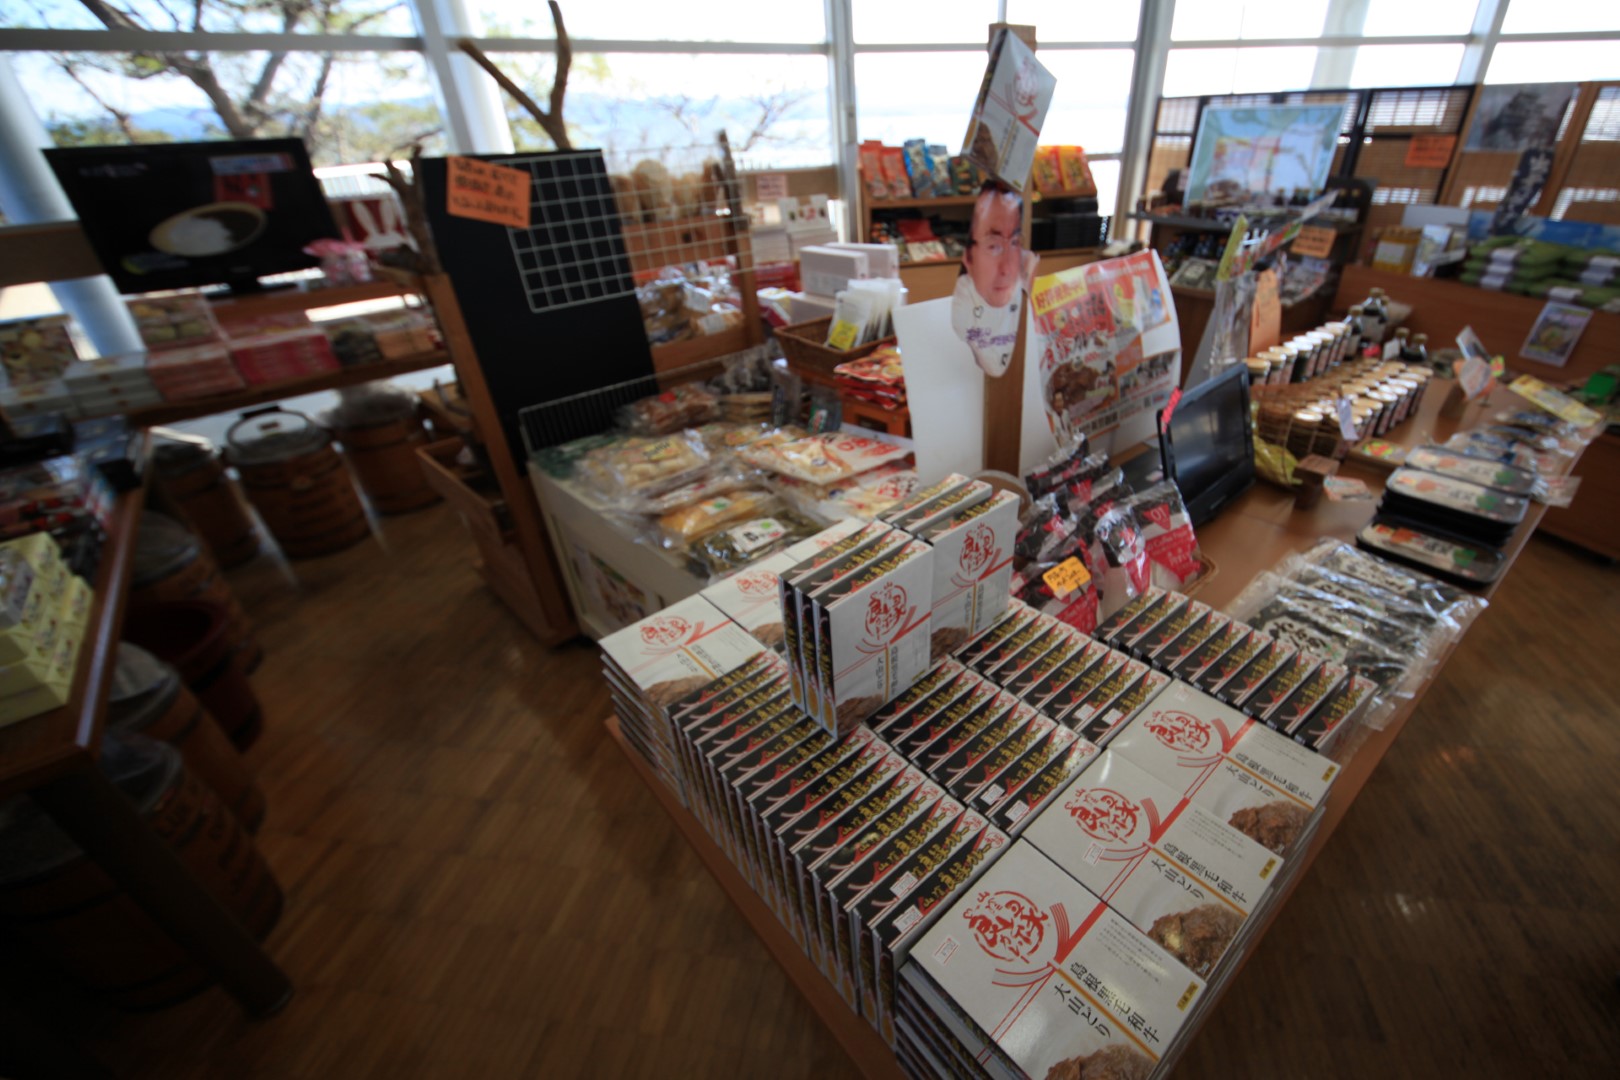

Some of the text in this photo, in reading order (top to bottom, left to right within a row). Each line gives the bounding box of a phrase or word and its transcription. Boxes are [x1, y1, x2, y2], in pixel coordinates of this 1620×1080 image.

[912, 826, 970, 877] 陰良縁カレー
[1162, 843, 1248, 904] 島根黒毛和牛
[1150, 858, 1206, 901] 大山どり
[1053, 984, 1112, 1039] 大山どり
[1069, 962, 1160, 1044] 島根黒毛和牛
